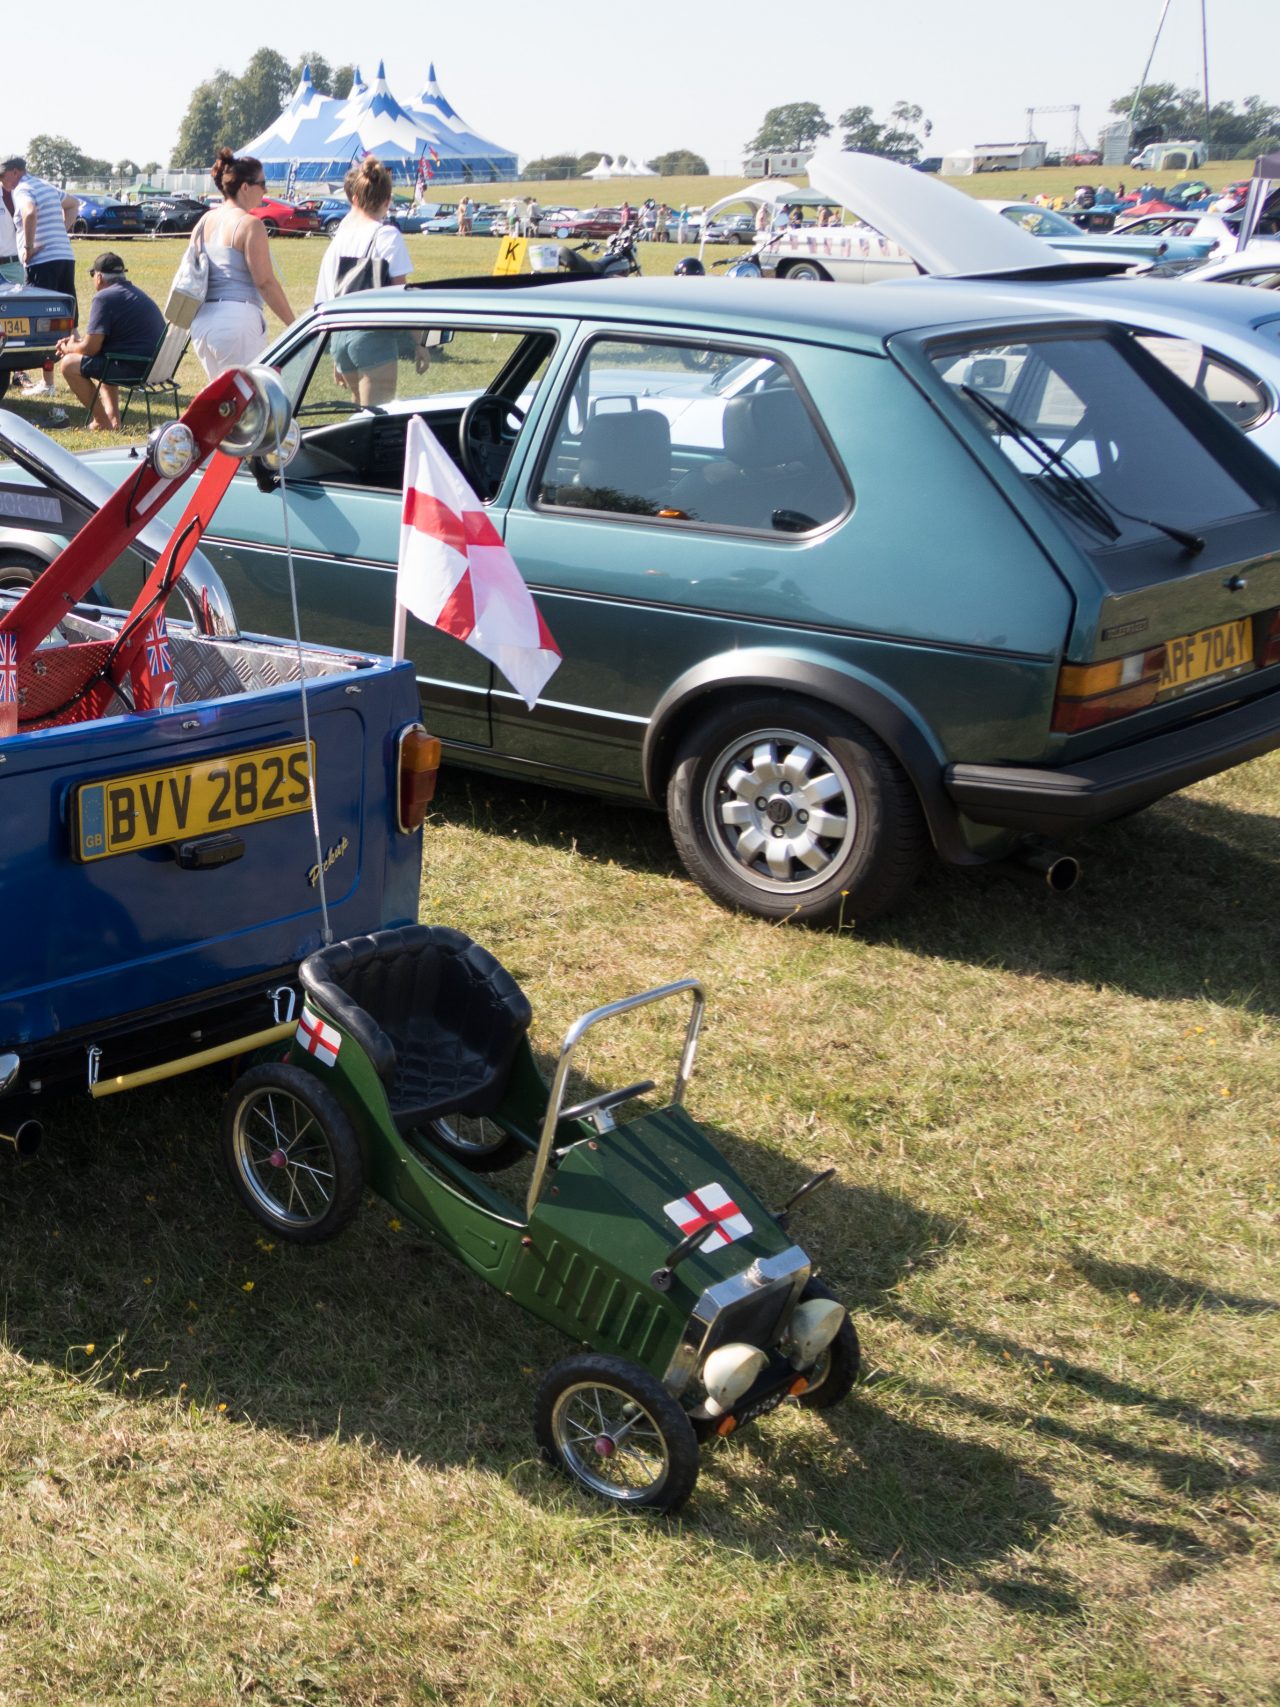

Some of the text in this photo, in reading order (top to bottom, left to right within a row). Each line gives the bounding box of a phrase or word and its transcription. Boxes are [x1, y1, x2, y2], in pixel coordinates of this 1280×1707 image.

[505, 242, 520, 261] K
[1161, 622, 1247, 687] APF 704Y
[109, 751, 310, 845] BVV 282S
[86, 832, 103, 849] GB
